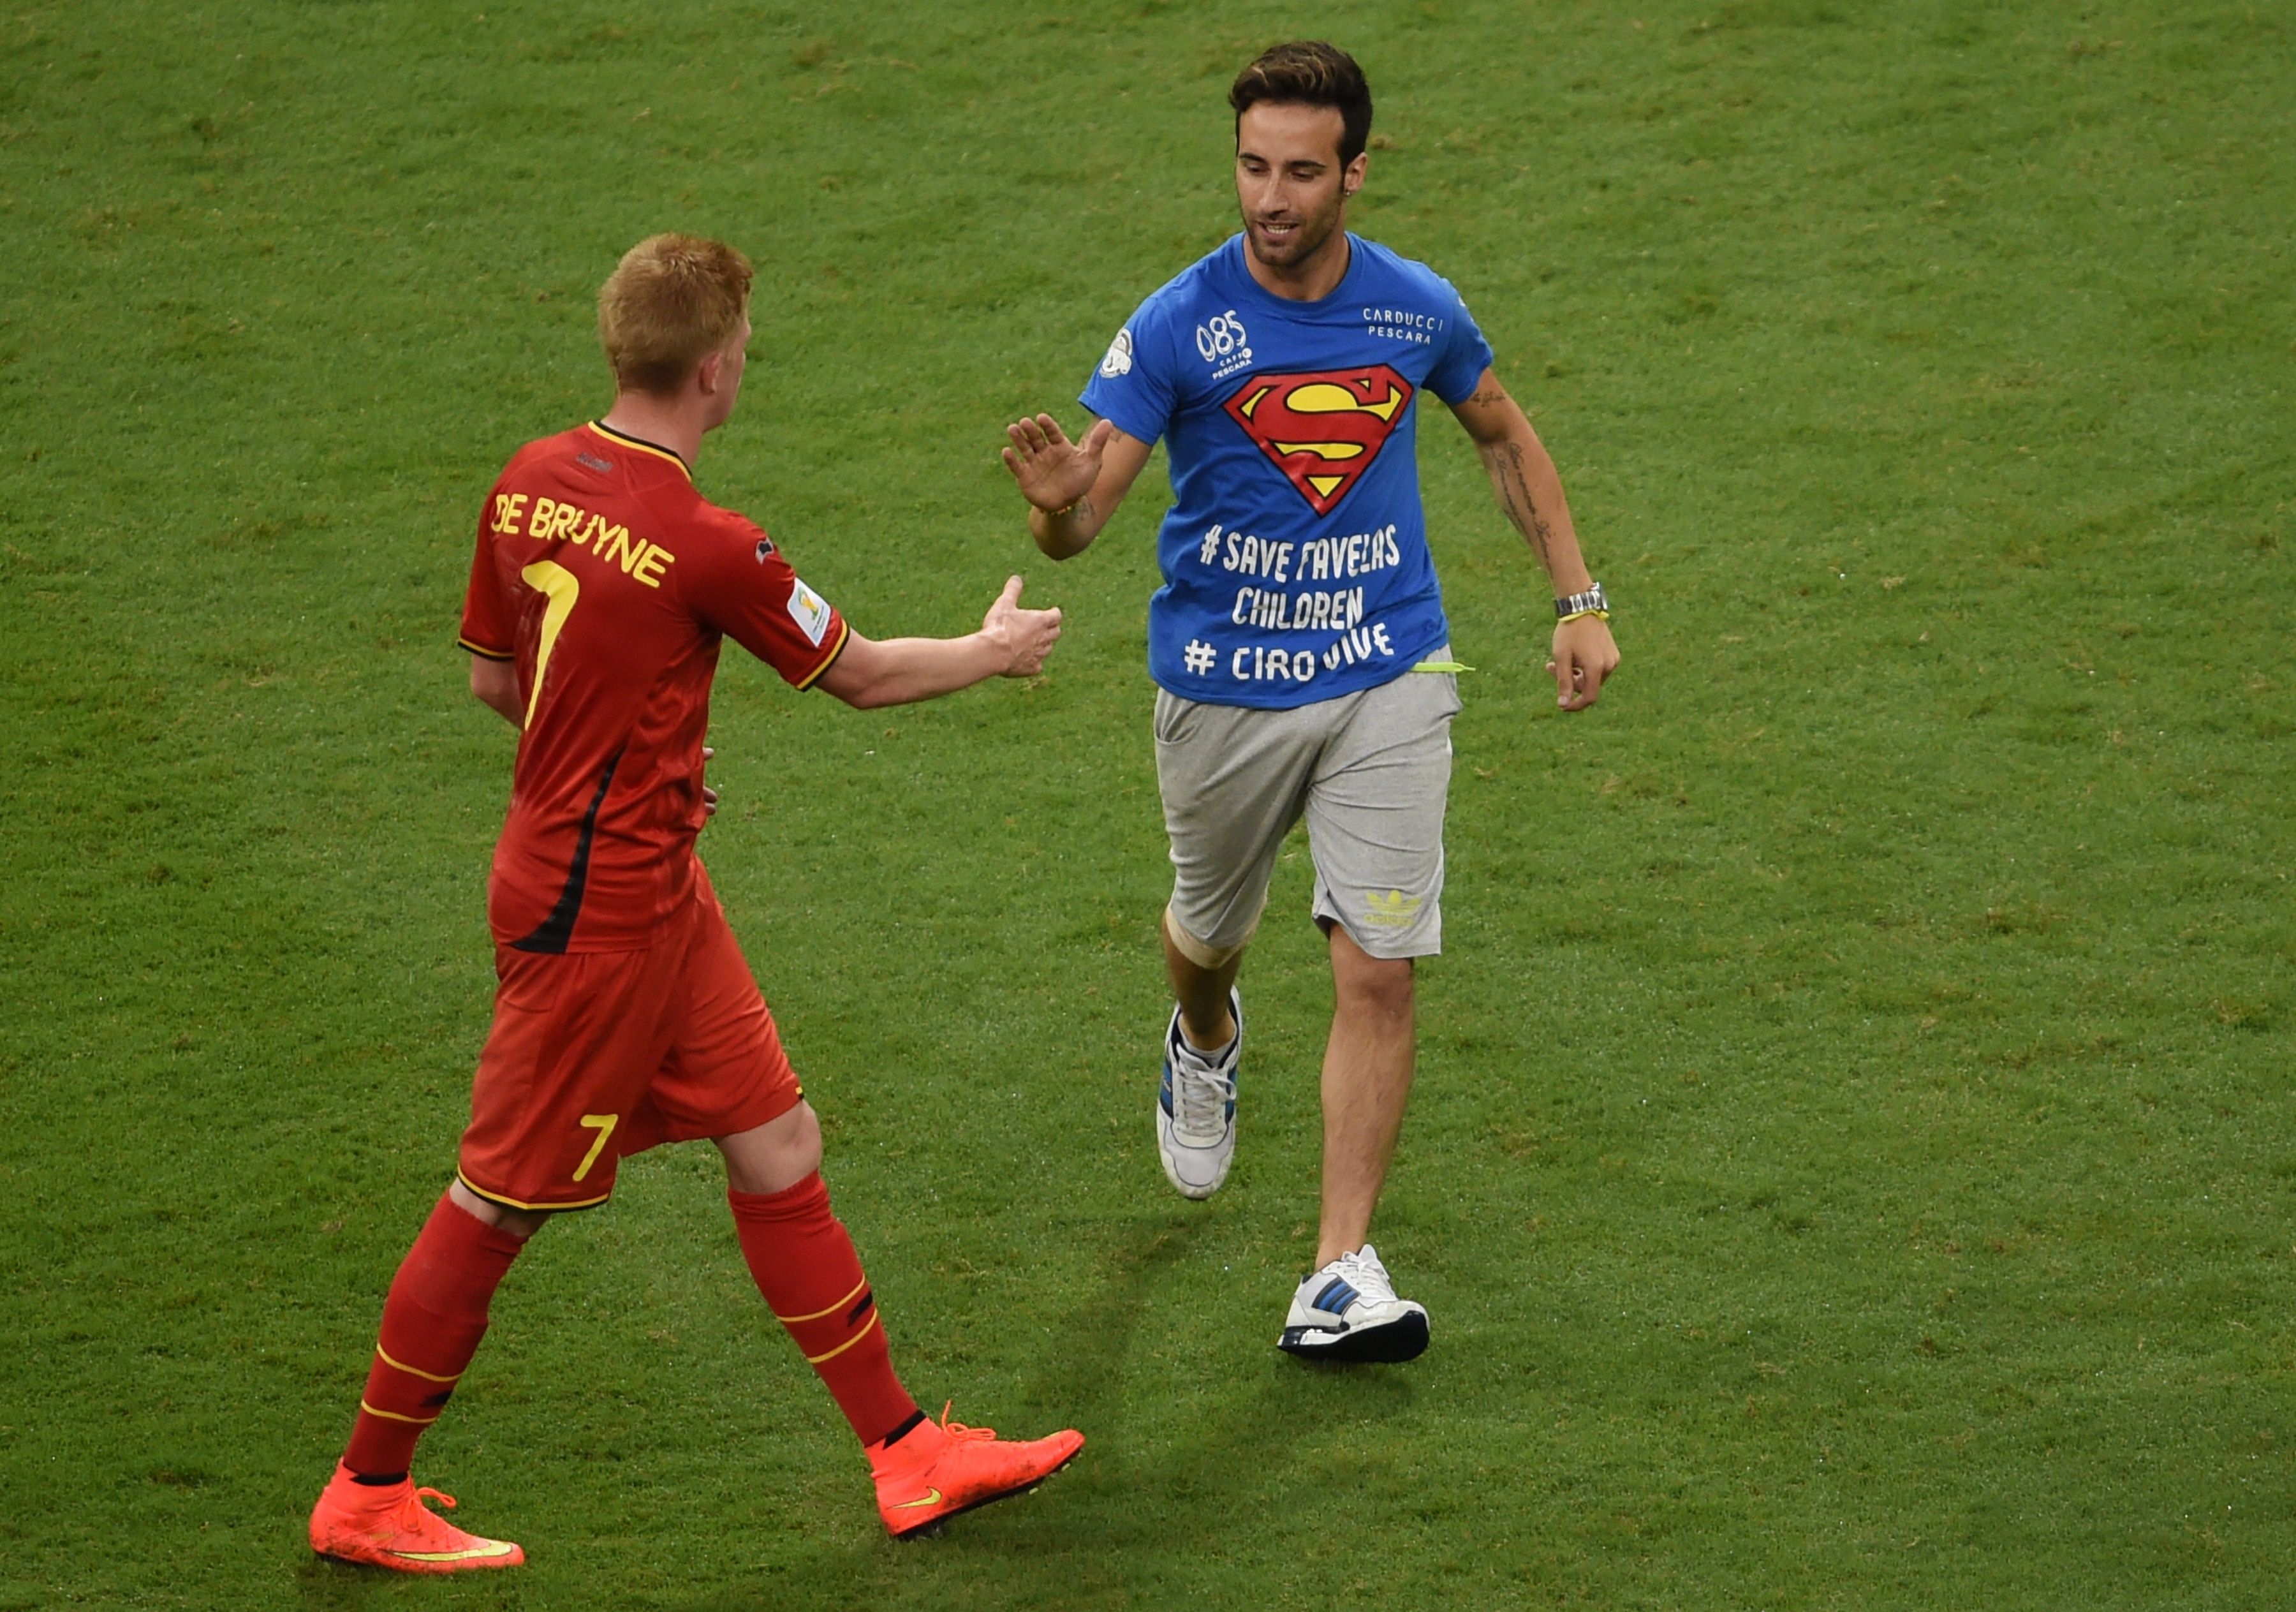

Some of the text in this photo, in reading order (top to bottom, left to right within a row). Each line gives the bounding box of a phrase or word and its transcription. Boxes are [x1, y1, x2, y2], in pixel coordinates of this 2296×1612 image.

[1196, 309, 1246, 362] 085
[1362, 307, 1443, 332] CARDUCCI
[1368, 325, 1431, 345] PESCARA
[1212, 359, 1253, 380] PESCARA
[491, 494, 675, 589] DE BRUYNE
[1295, 524, 1400, 581] FAVELAS
[1232, 586, 1364, 630] CHILDREN
[521, 560, 580, 730] 7
[1232, 646, 1316, 682] CIRO
[1322, 622, 1395, 671] VIVE
[572, 1114, 619, 1181] 7
